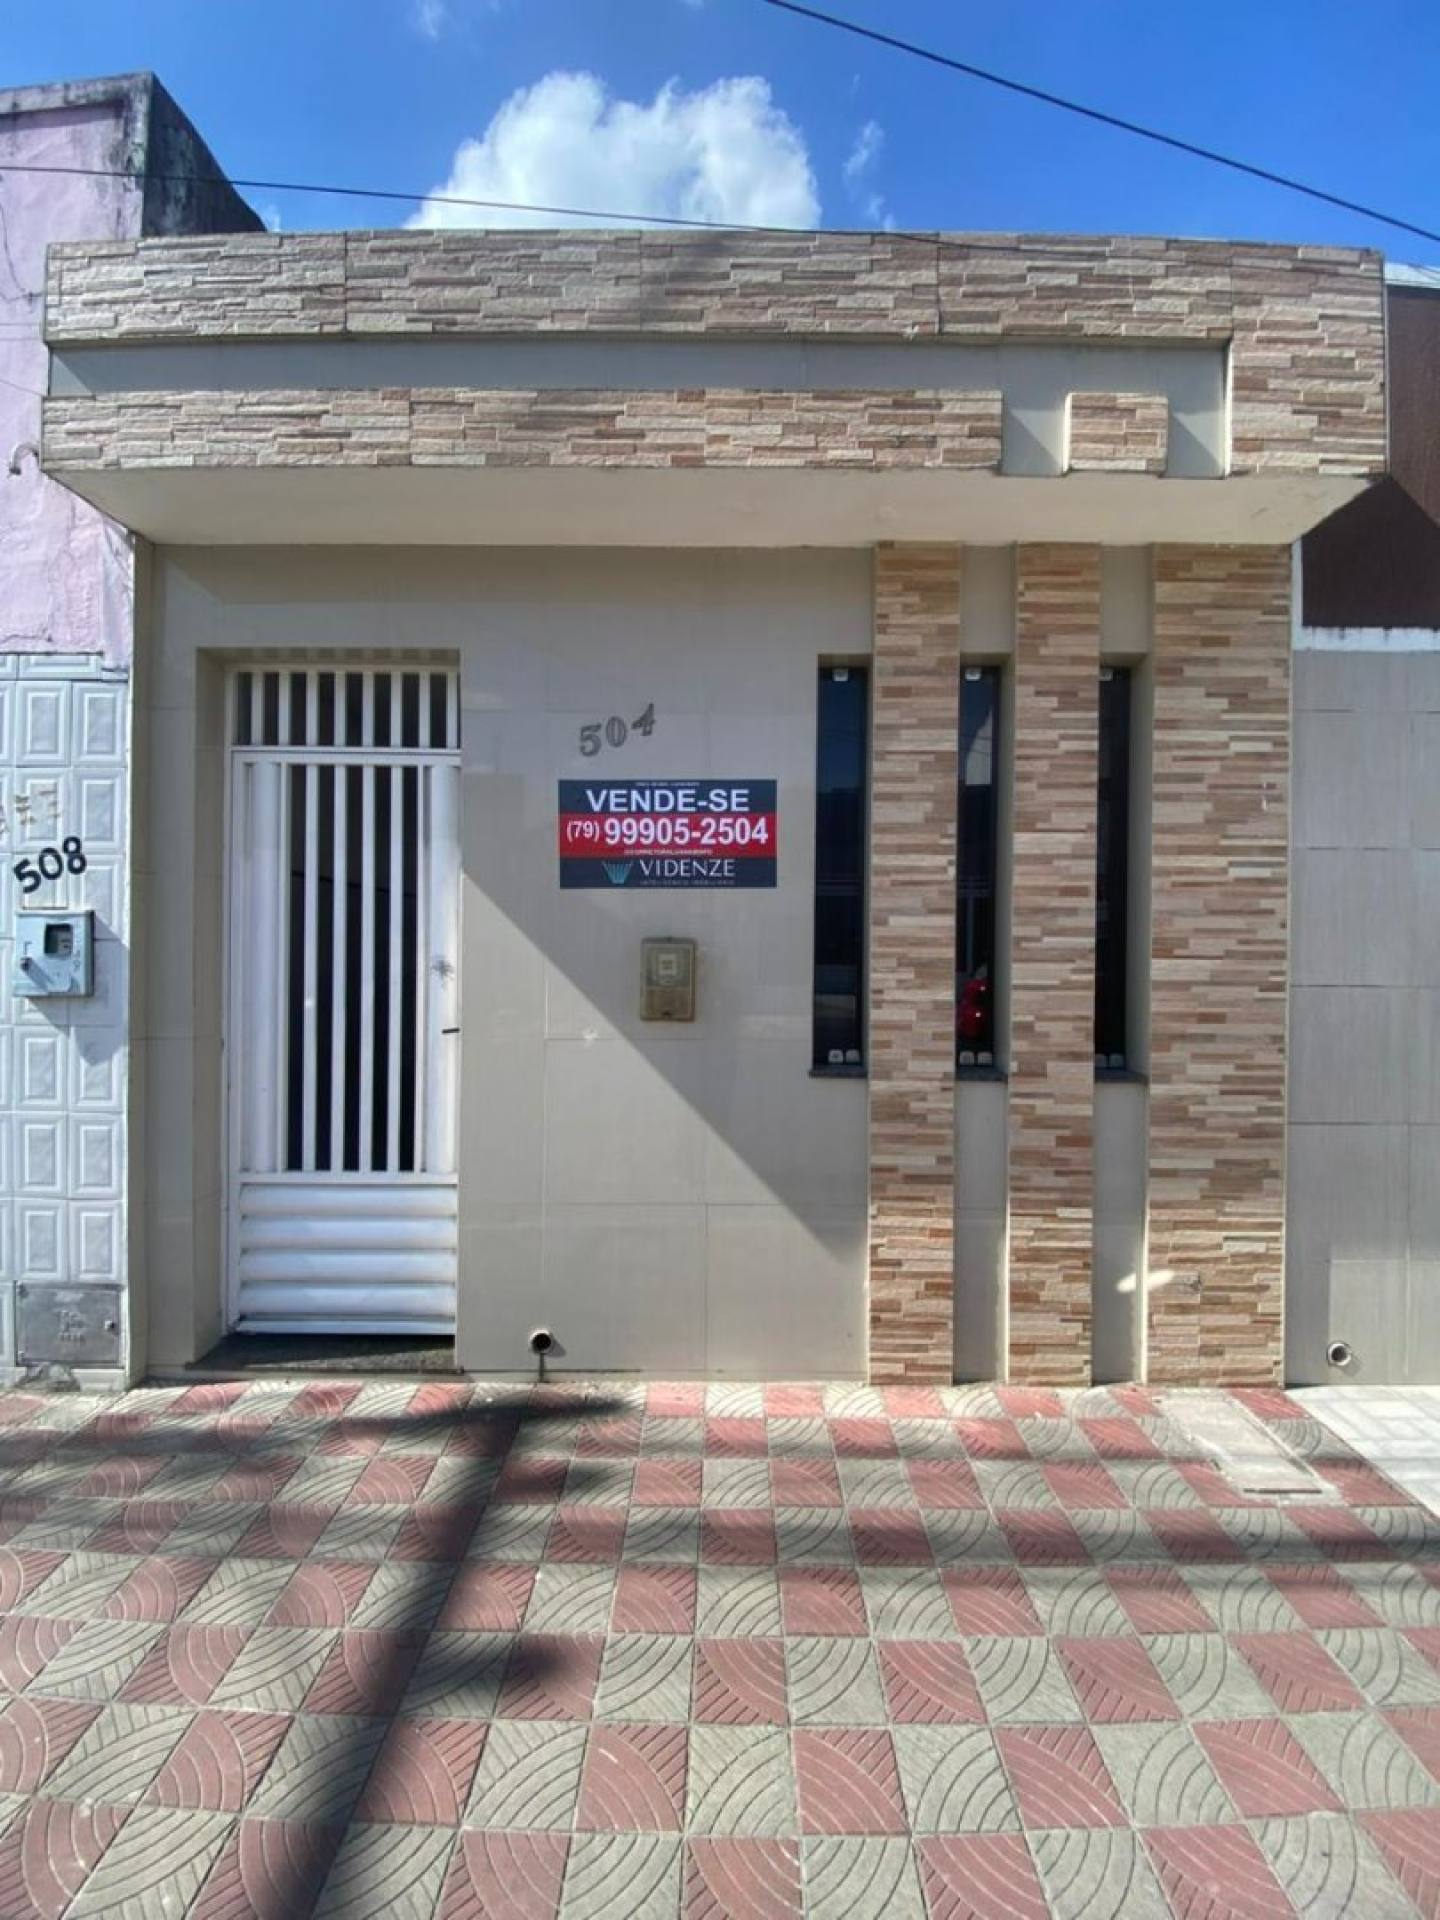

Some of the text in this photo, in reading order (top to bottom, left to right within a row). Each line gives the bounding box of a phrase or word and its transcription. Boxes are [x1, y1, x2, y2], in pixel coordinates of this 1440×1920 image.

[579, 703, 656, 757] 504
[585, 788, 750, 812] VENDE-SE
[566, 817, 769, 845] (79) 99905-2504
[14, 836, 87, 893] 508
[639, 858, 736, 877] VIDENZE
